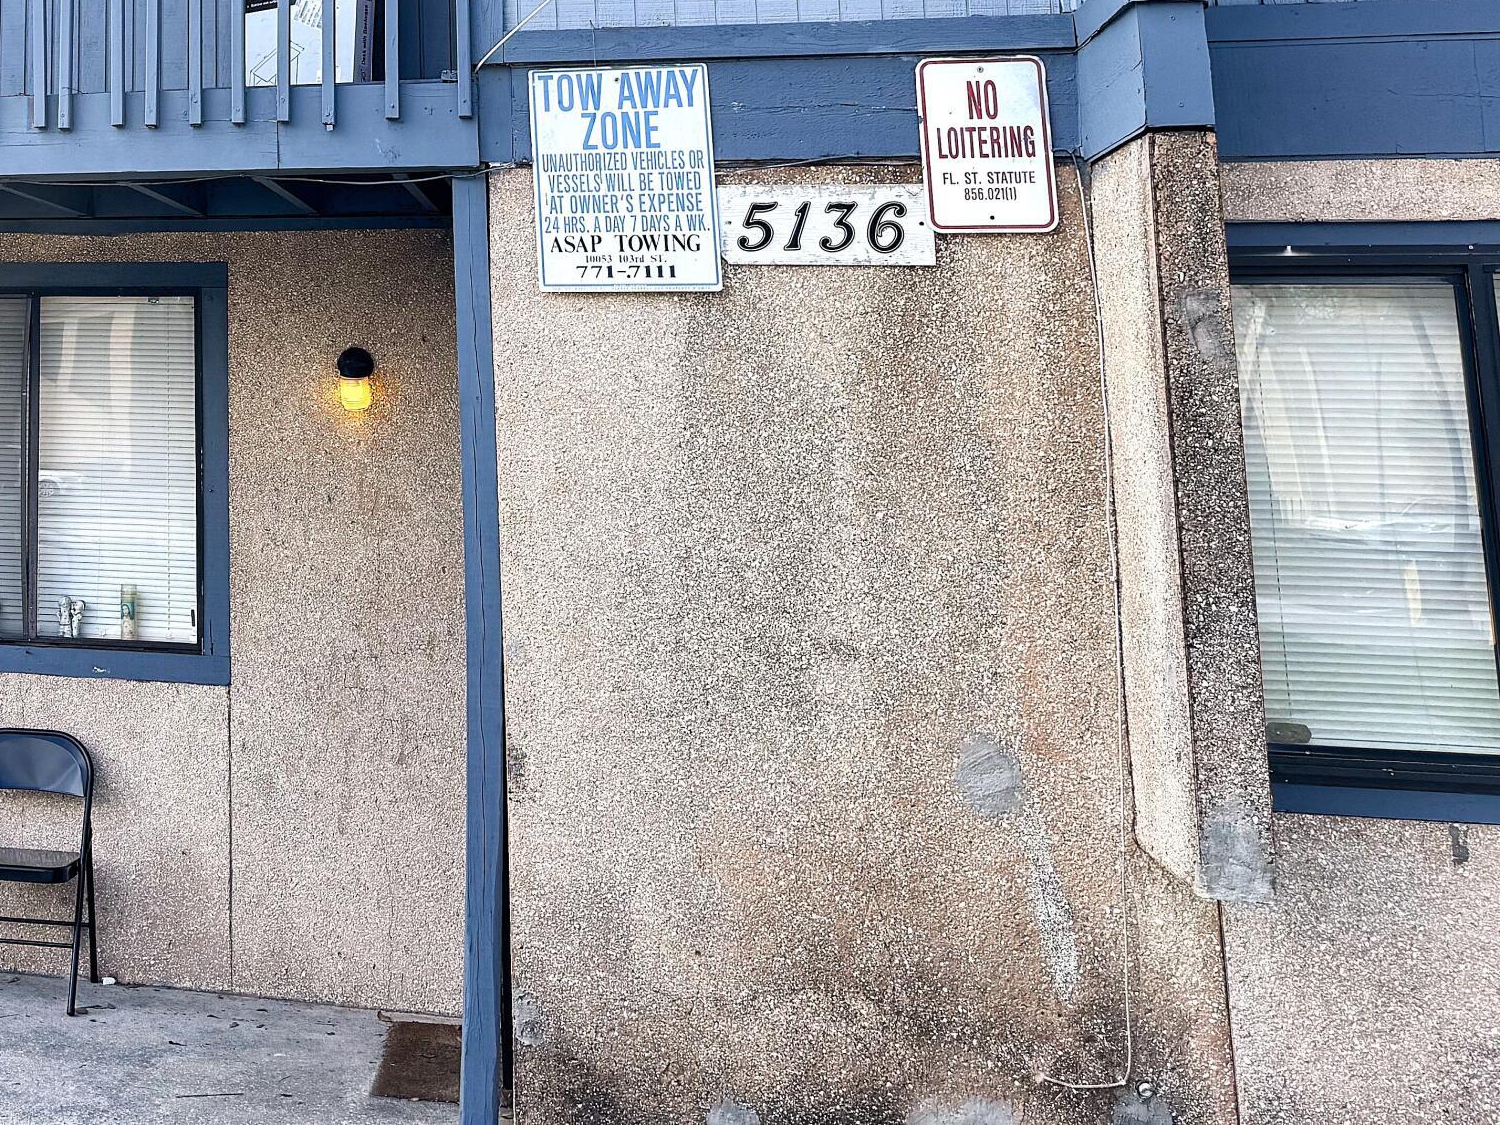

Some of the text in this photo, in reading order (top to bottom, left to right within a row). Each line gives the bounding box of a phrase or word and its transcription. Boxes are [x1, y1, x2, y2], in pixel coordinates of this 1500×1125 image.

[537, 69, 699, 112] TOW AWAY
[966, 79, 999, 120] NO
[580, 110, 661, 151] ZONE
[936, 125, 1036, 160] LOITERING
[542, 149, 705, 173] UNAUTHORIZED VEHICLES OR
[548, 171, 701, 194] VESSELS WILL BE TOWED
[942, 170, 1036, 185] FL. ST. STATUTE
[549, 193, 704, 215] AT OWNER'S EXPENSE
[964, 186, 1018, 202] 856.021(1)
[544, 213, 711, 234] 24 HRS. A DAY 7 DAYS A WK.
[737, 200, 908, 254] 5136
[550, 234, 701, 253] ASAP TOWING
[618, 254, 645, 264] 103rd
